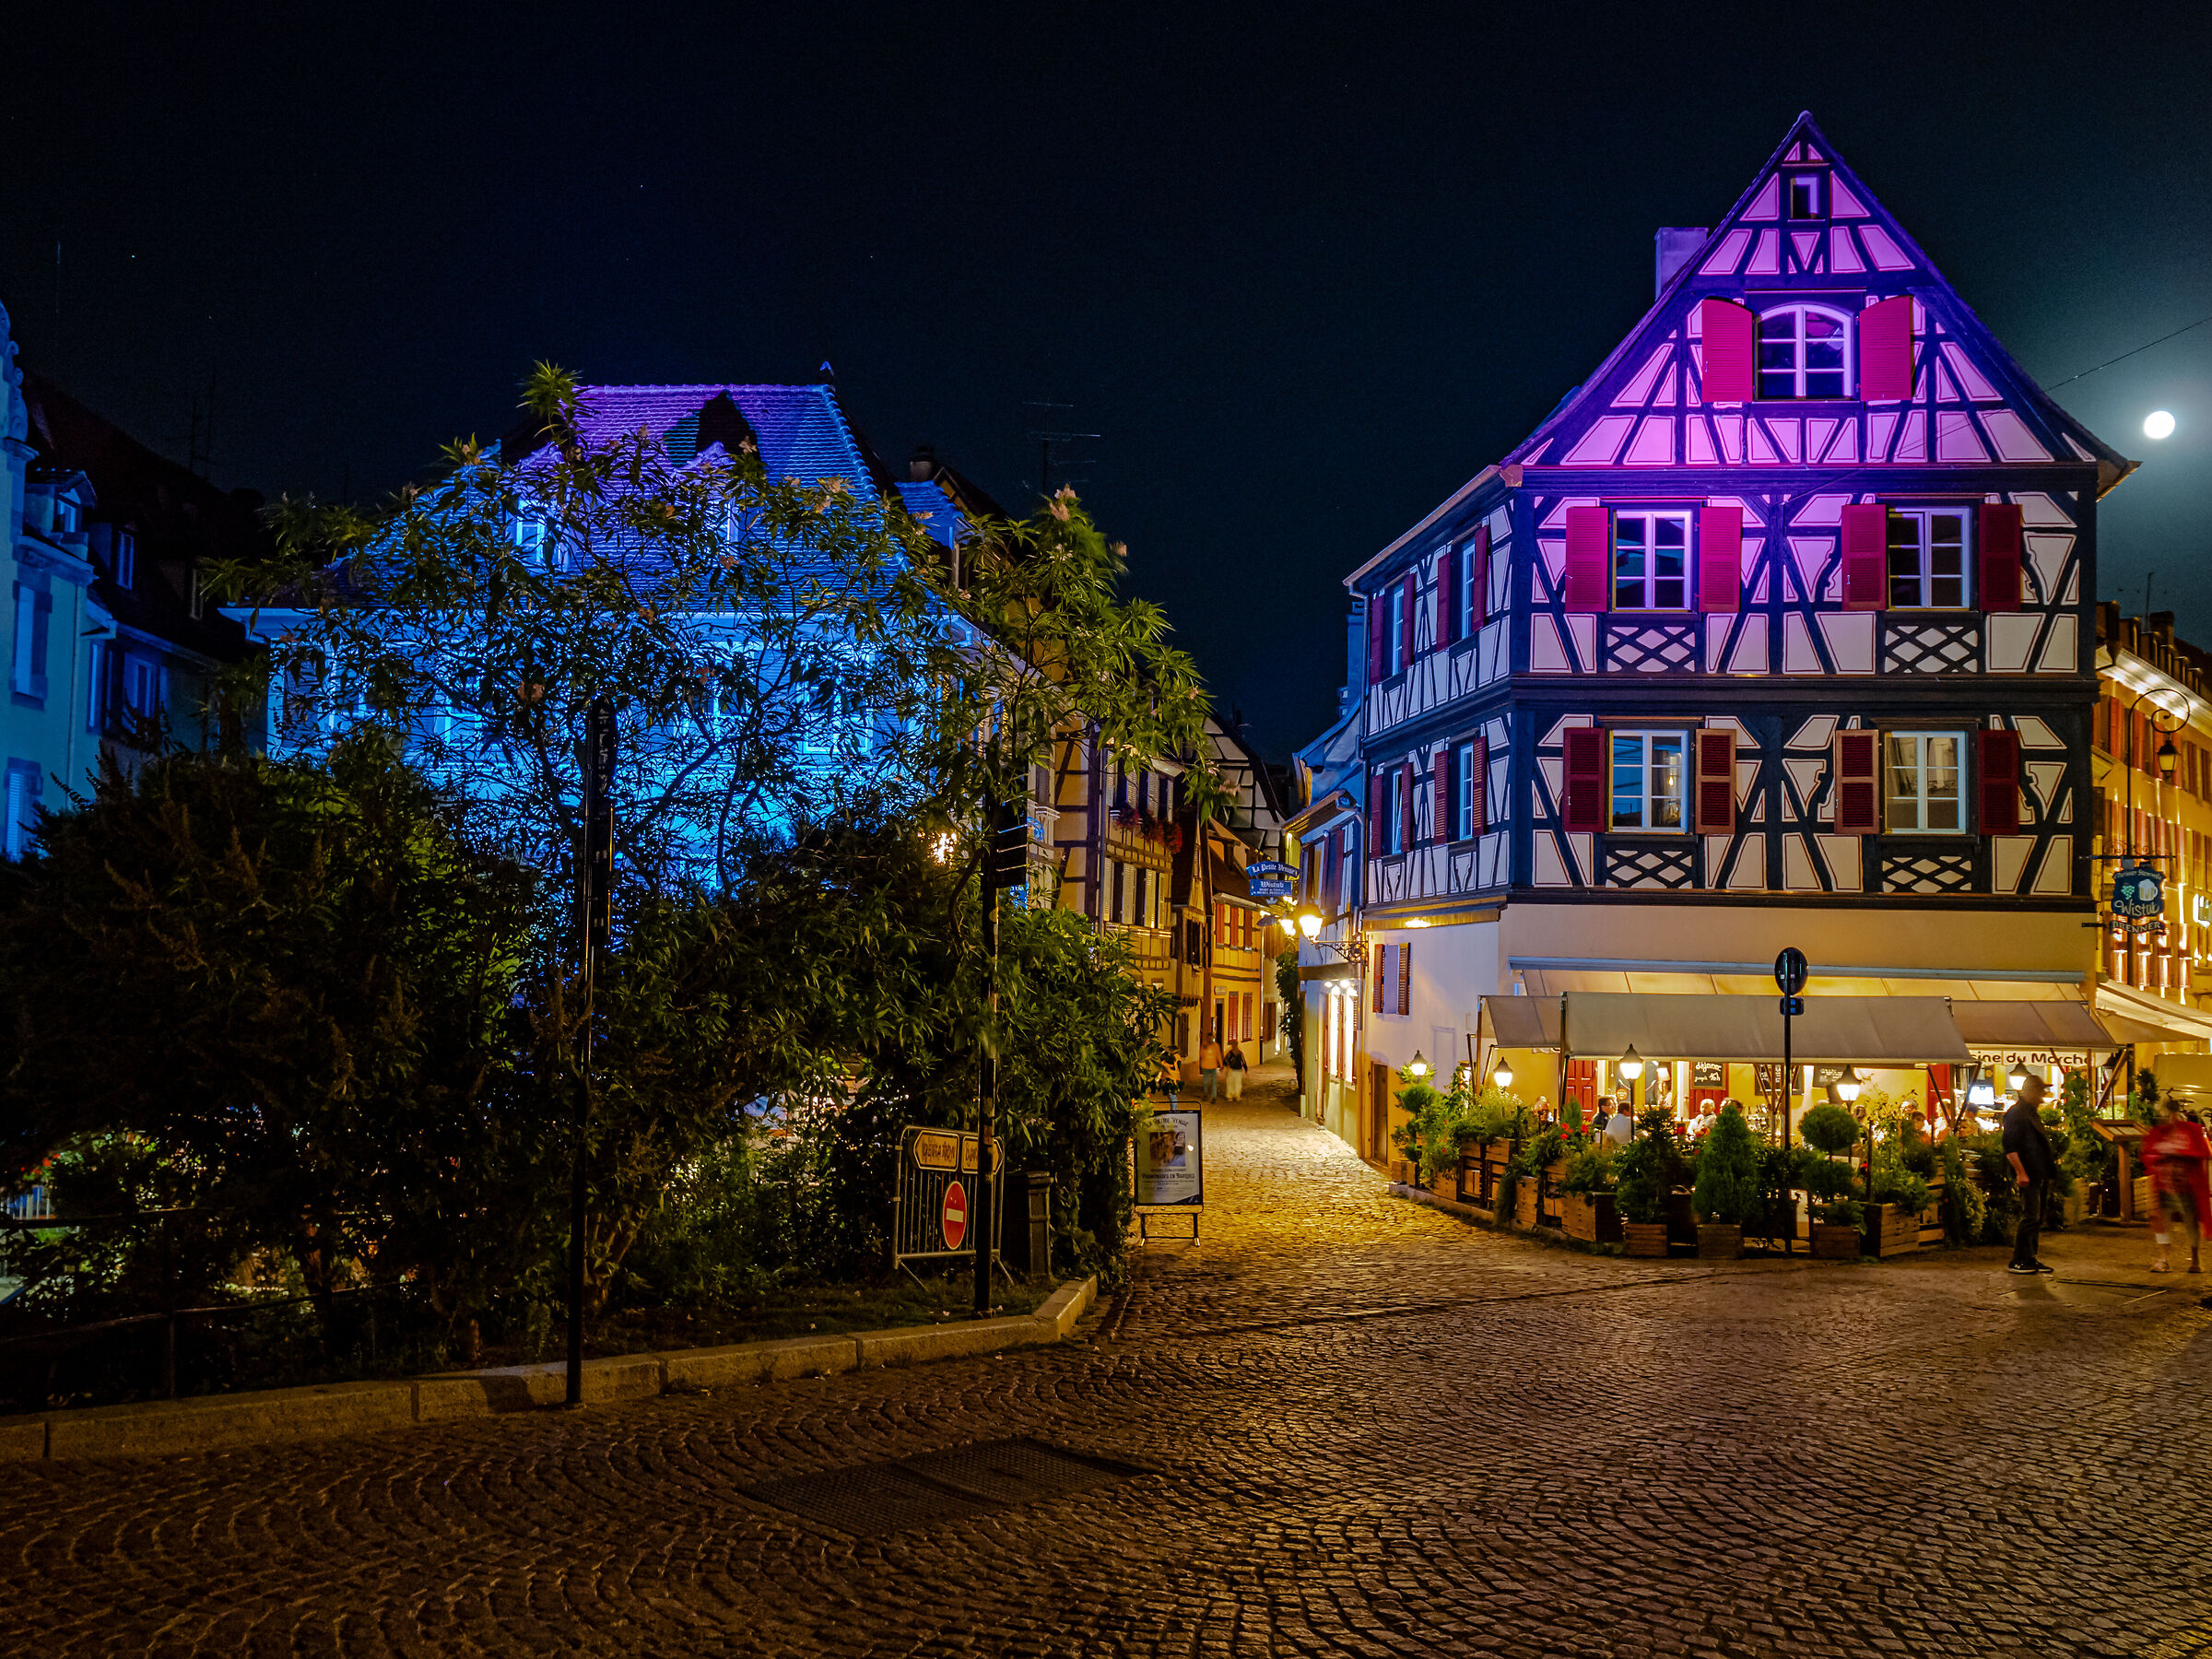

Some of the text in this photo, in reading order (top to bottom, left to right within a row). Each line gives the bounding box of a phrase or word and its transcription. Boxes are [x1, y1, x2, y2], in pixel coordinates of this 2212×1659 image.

[1278, 865, 1294, 874] Venise
[2112, 921, 2161, 934] BRENNER
[2006, 1053, 2026, 1063] du
